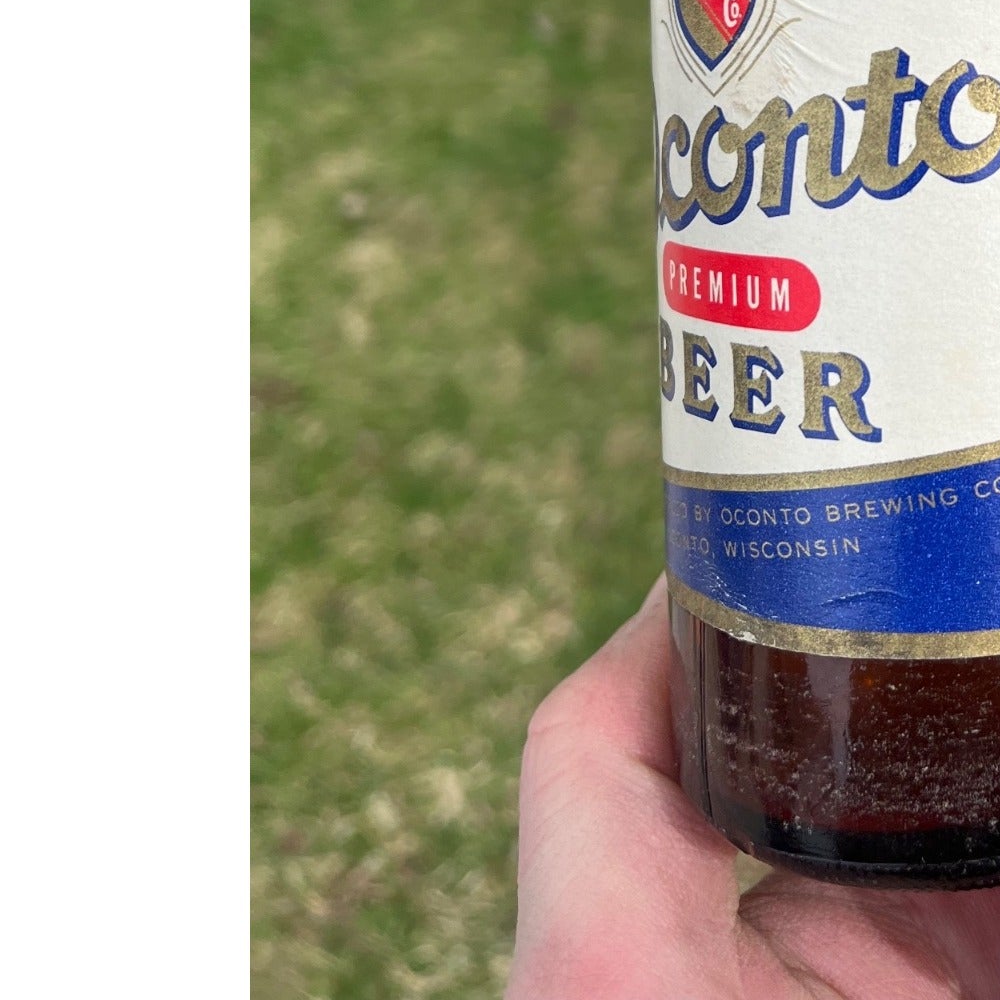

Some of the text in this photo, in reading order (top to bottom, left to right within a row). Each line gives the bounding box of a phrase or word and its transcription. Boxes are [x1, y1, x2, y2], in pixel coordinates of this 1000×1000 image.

[669, 262, 790, 312] PREMIUM
[660, 315, 882, 443] BEER
[694, 504, 711, 523] BY
[720, 506, 811, 526] OCONTO
[825, 488, 959, 522] BREWING
[723, 536, 860, 559] WISCONSIN
